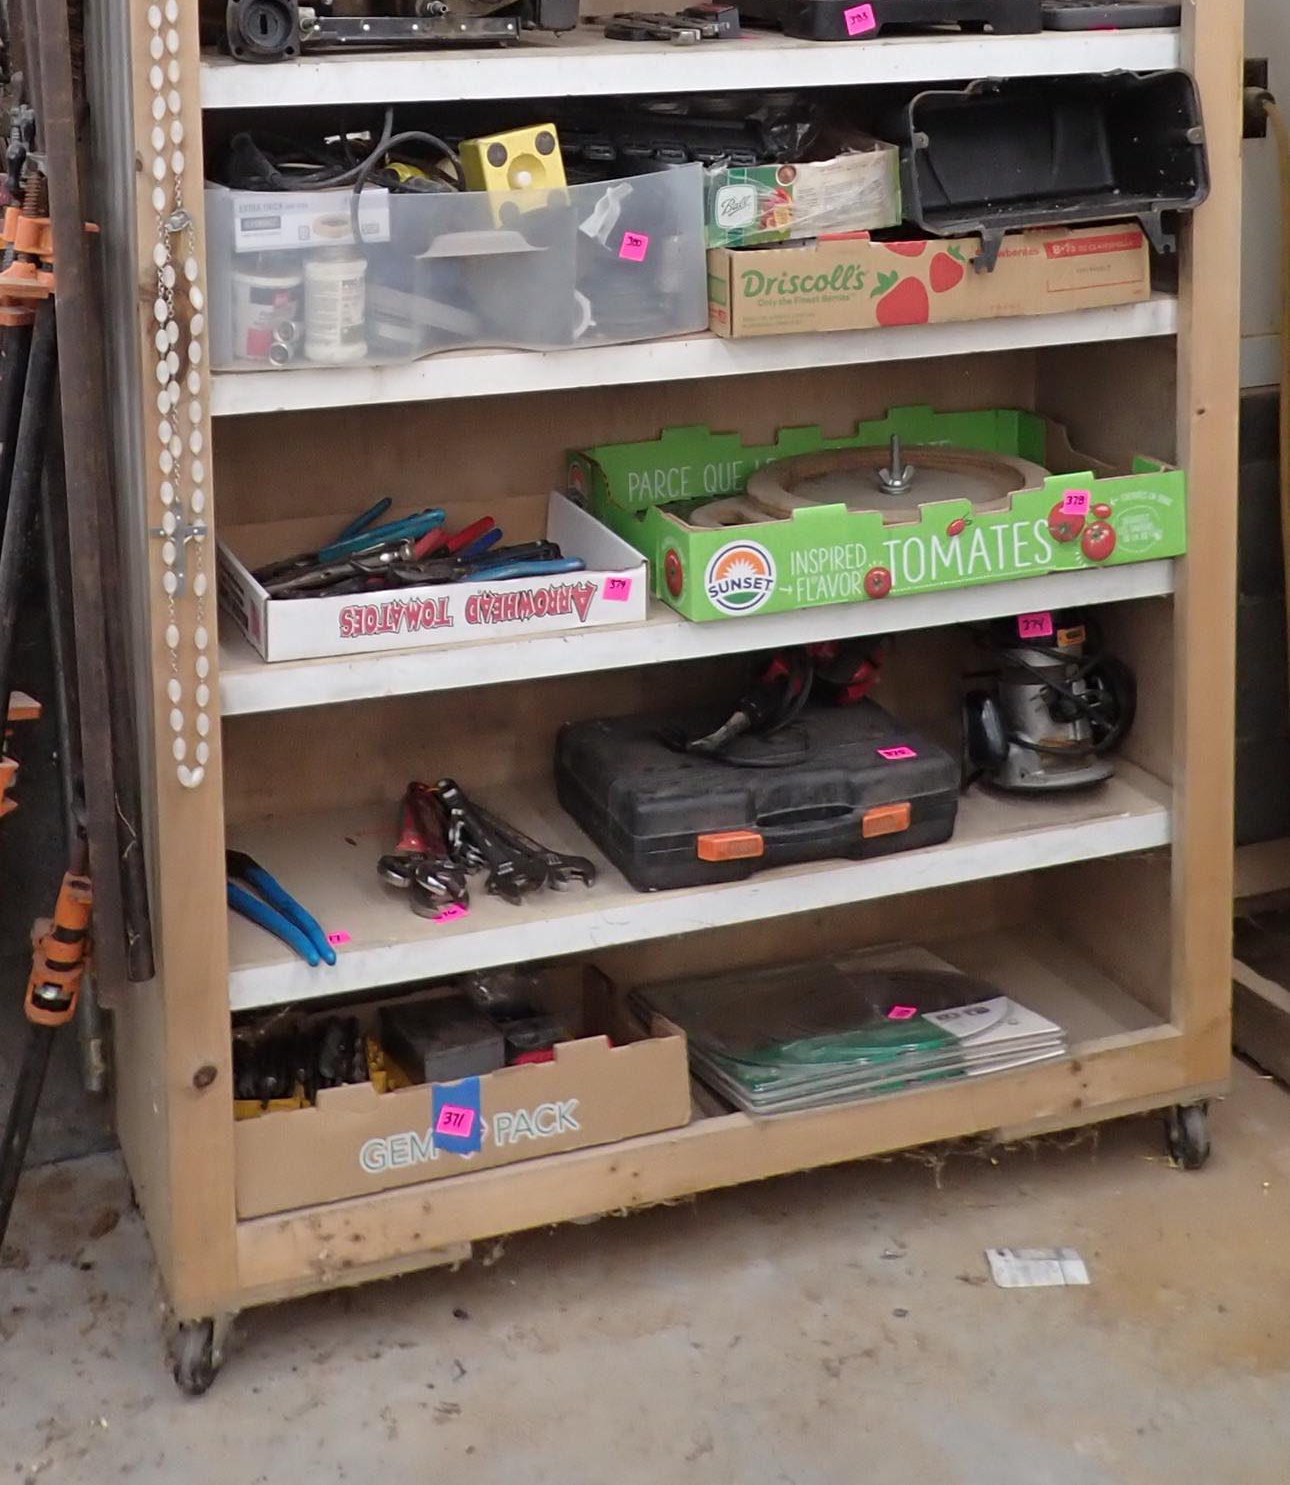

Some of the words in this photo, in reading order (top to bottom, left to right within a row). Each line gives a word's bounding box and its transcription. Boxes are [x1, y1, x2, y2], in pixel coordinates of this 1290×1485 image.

[741, 264, 865, 298] Driscoll's
[757, 299, 777, 307] Only
[628, 467, 691, 502] PARCE
[703, 460, 743, 493] QUE
[790, 543, 867, 576] INSPIRED
[883, 519, 1053, 586] TOMATES
[465, 580, 597, 624] ARROWHEAD
[708, 578, 774, 599] SUNSET
[796, 571, 863, 602] FLAVOR
[339, 596, 454, 638] TOMATOES
[445, 1112, 464, 1128] 371
[494, 1099, 580, 1146] PACK
